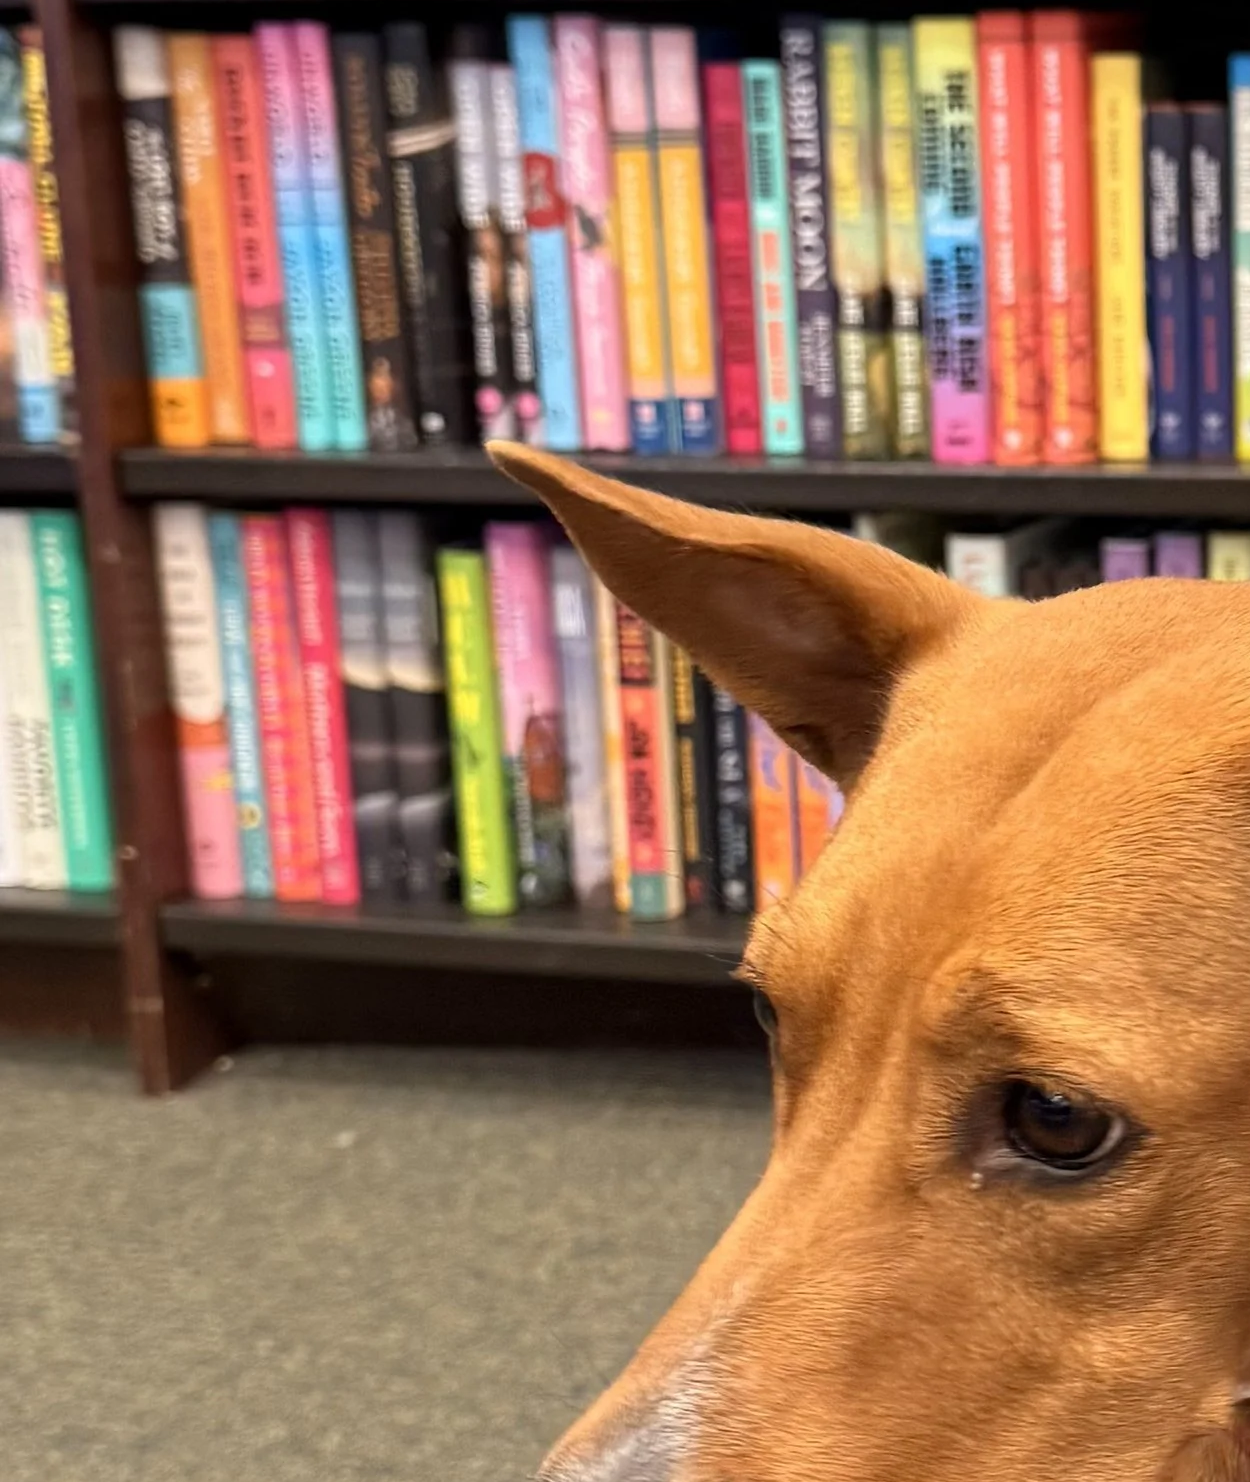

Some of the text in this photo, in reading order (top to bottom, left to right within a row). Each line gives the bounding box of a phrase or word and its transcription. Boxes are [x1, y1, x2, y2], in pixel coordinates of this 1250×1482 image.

[782, 28, 827, 292] RABBIT MOON
[946, 70, 976, 218] THE SECOND
[956, 244, 976, 328] GARTH
